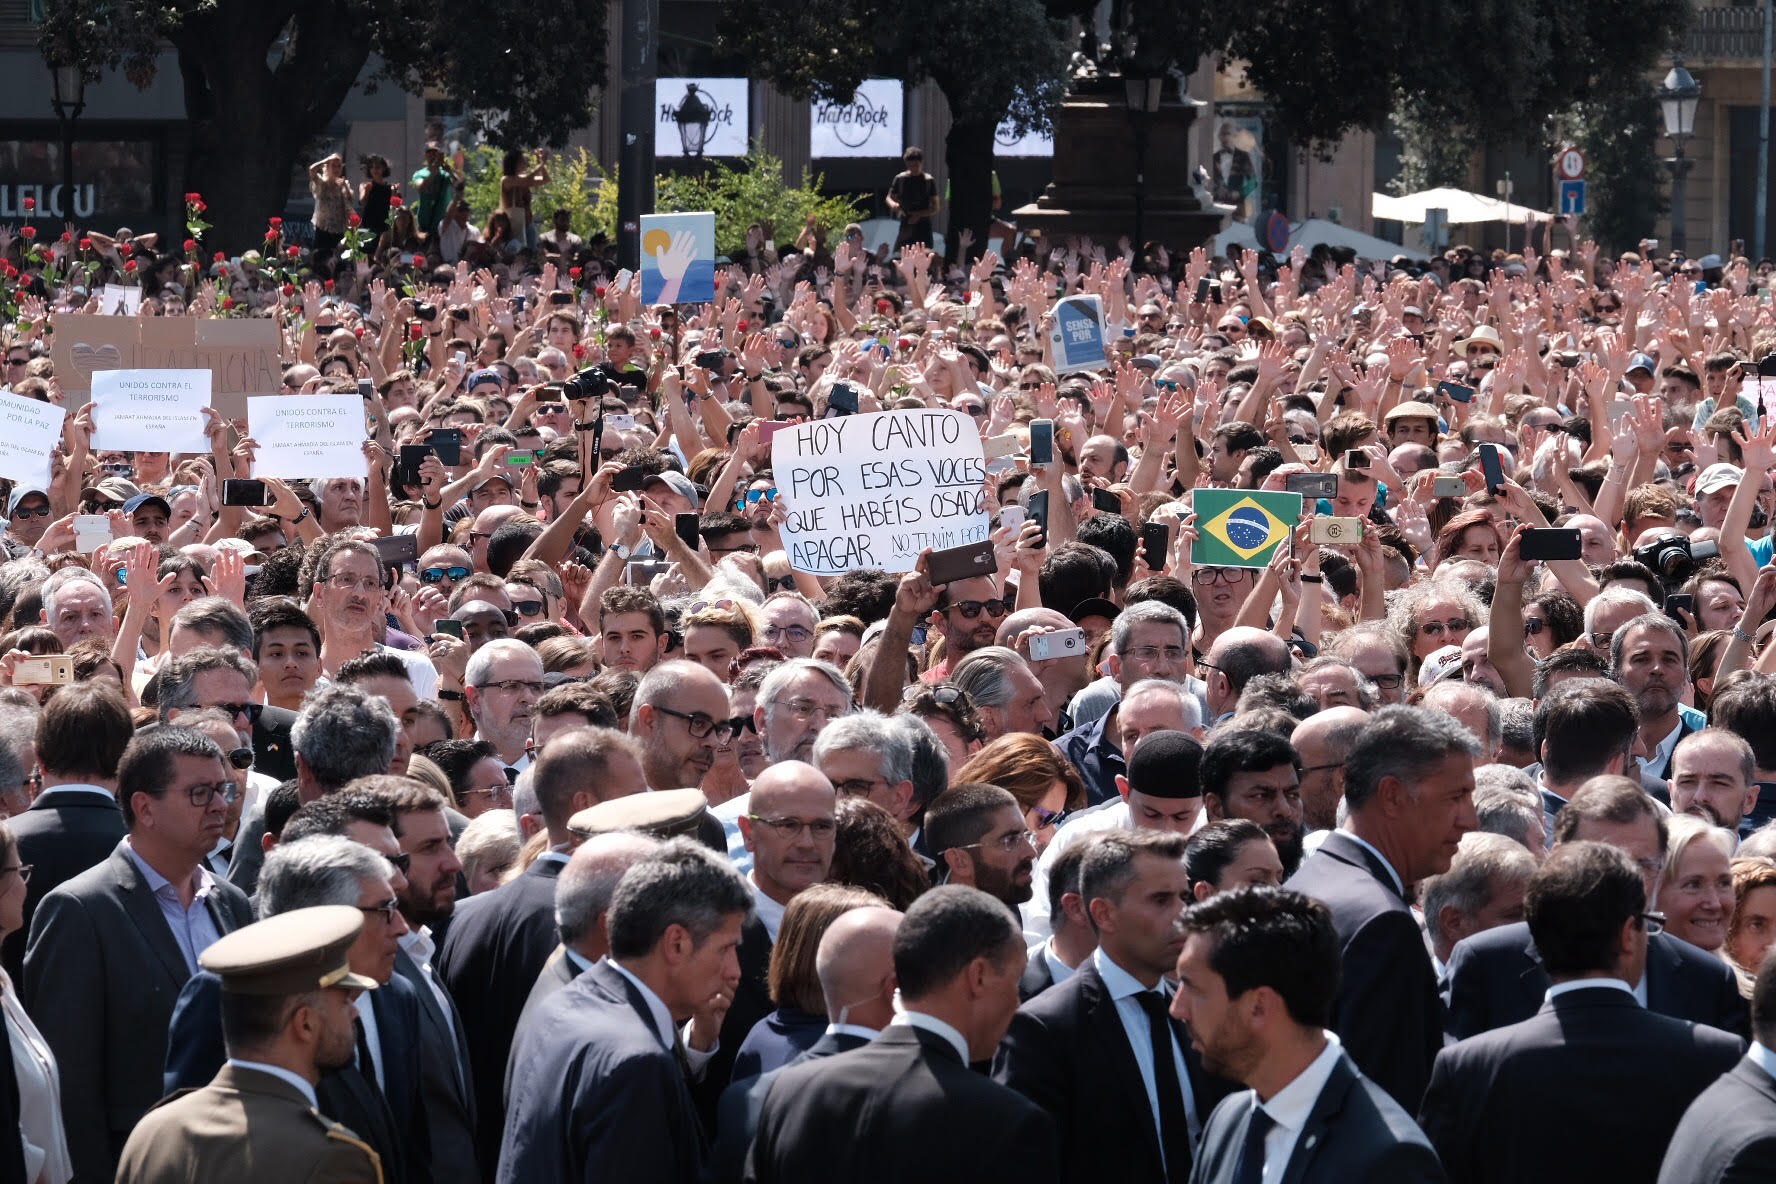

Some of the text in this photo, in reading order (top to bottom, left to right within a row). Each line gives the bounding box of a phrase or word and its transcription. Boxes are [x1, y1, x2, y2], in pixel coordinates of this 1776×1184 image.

[817, 103, 888, 127] Hard Rock
[1066, 318, 1095, 331] SENSE
[1072, 330, 1092, 341] POR
[129, 394, 180, 402] TERRORISMO
[275, 409, 305, 417] UNIDOS
[306, 408, 337, 416] CONTRA
[7, 413, 50, 430] POR LA PAZ
[286, 421, 335, 429] TERRORISMO
[797, 414, 959, 456] HOY CANTO
[792, 457, 986, 499] POR ESAS VOCES
[786, 507, 827, 533] QUE
[841, 493, 922, 530] HABÉIS
[793, 534, 882, 569] APAGAR.
[892, 534, 910, 552] NO
